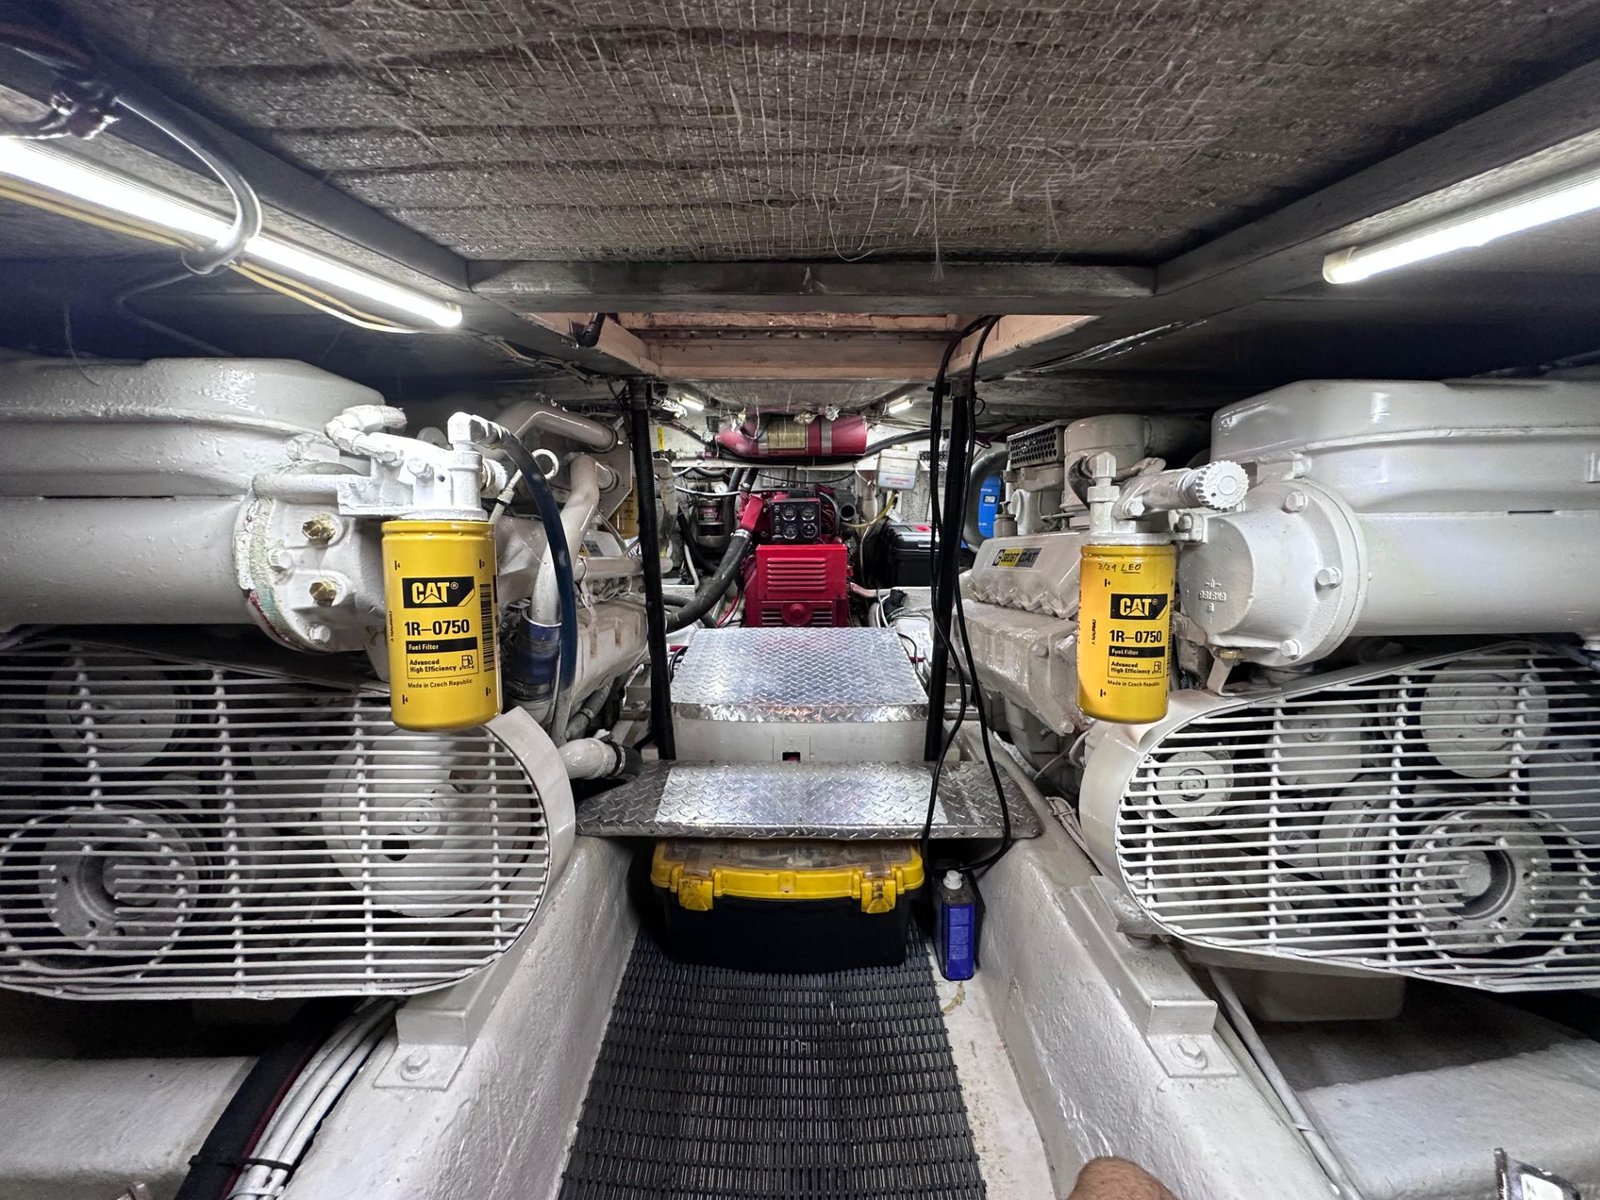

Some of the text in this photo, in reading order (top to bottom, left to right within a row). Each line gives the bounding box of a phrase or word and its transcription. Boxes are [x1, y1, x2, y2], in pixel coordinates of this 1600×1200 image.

[1120, 564, 1141, 572] LEO
[404, 619, 470, 636] 1R-0750
[1109, 630, 1162, 643] 1R-0750
